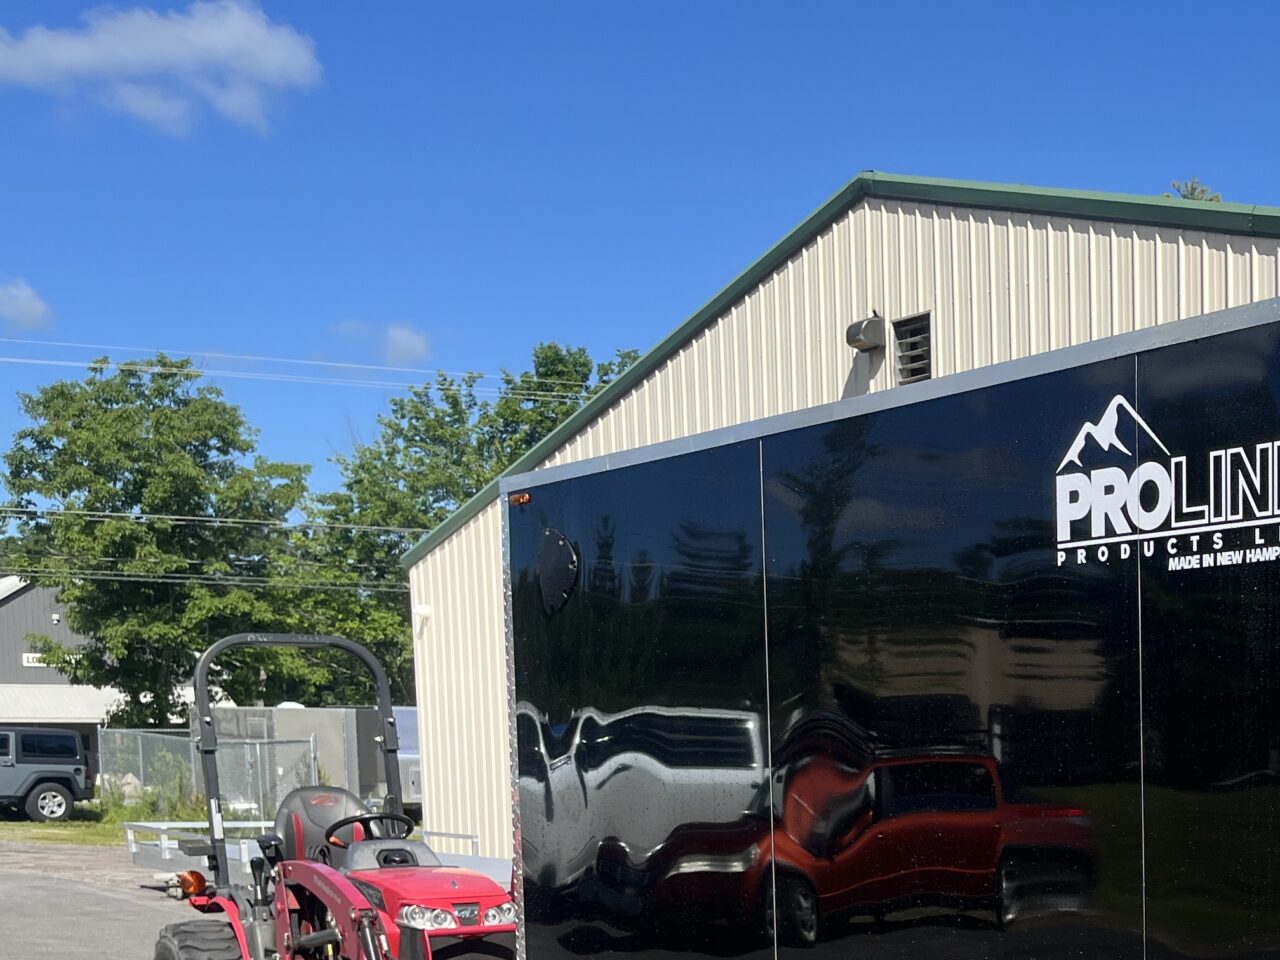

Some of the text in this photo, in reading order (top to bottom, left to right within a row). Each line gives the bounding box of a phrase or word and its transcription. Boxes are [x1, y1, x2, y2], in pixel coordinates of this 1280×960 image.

[1057, 532, 1223, 566] PRODUCTS
[1168, 555, 1200, 571] MADE
[1202, 553, 1214, 568] IN
[1216, 550, 1243, 566] NEW
